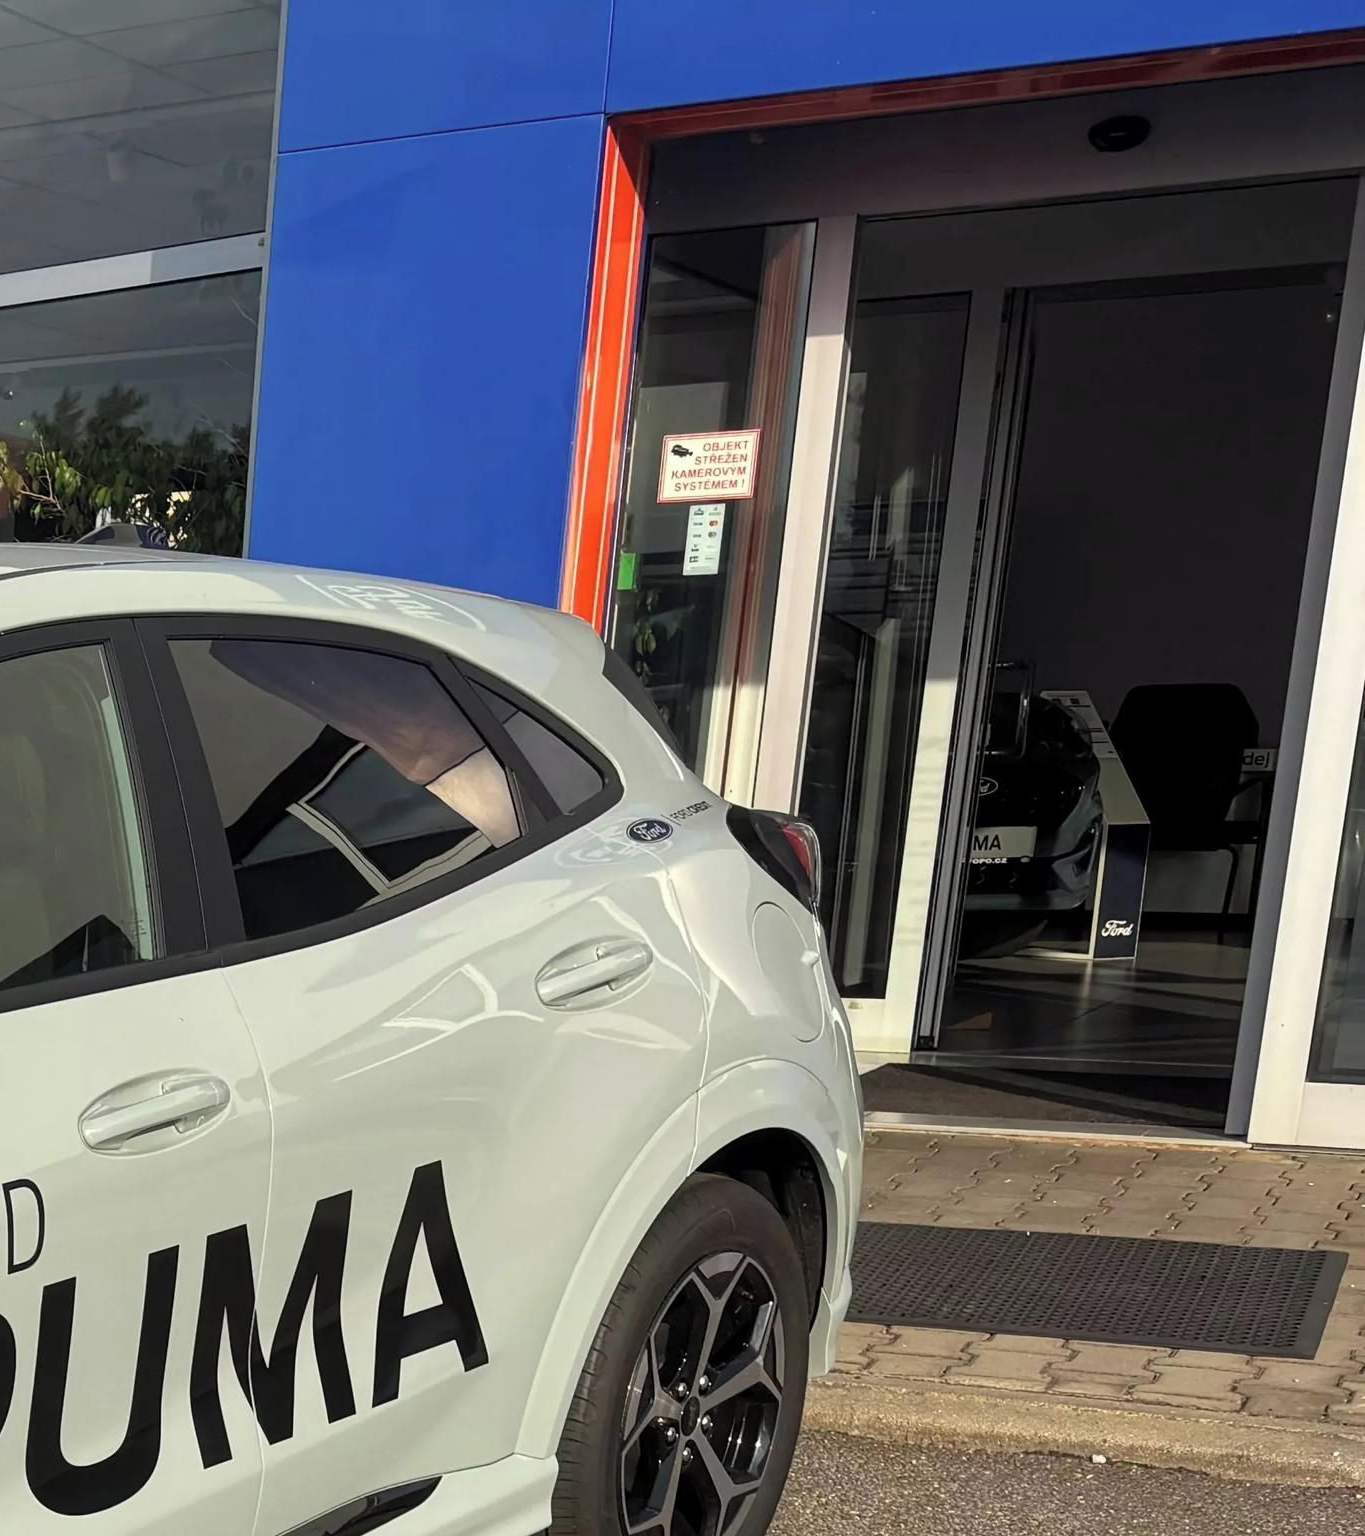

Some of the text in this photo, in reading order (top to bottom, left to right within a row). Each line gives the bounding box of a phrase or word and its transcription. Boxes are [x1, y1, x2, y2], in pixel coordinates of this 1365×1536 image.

[703, 440, 749, 452] OBJEKT
[695, 453, 748, 465] STŘEŽEN
[671, 465, 747, 479] KAMEROVÝM
[674, 479, 738, 491] SYSTÉMEM
[633, 822, 667, 840] Ford
[1101, 920, 1134, 938] Ford
